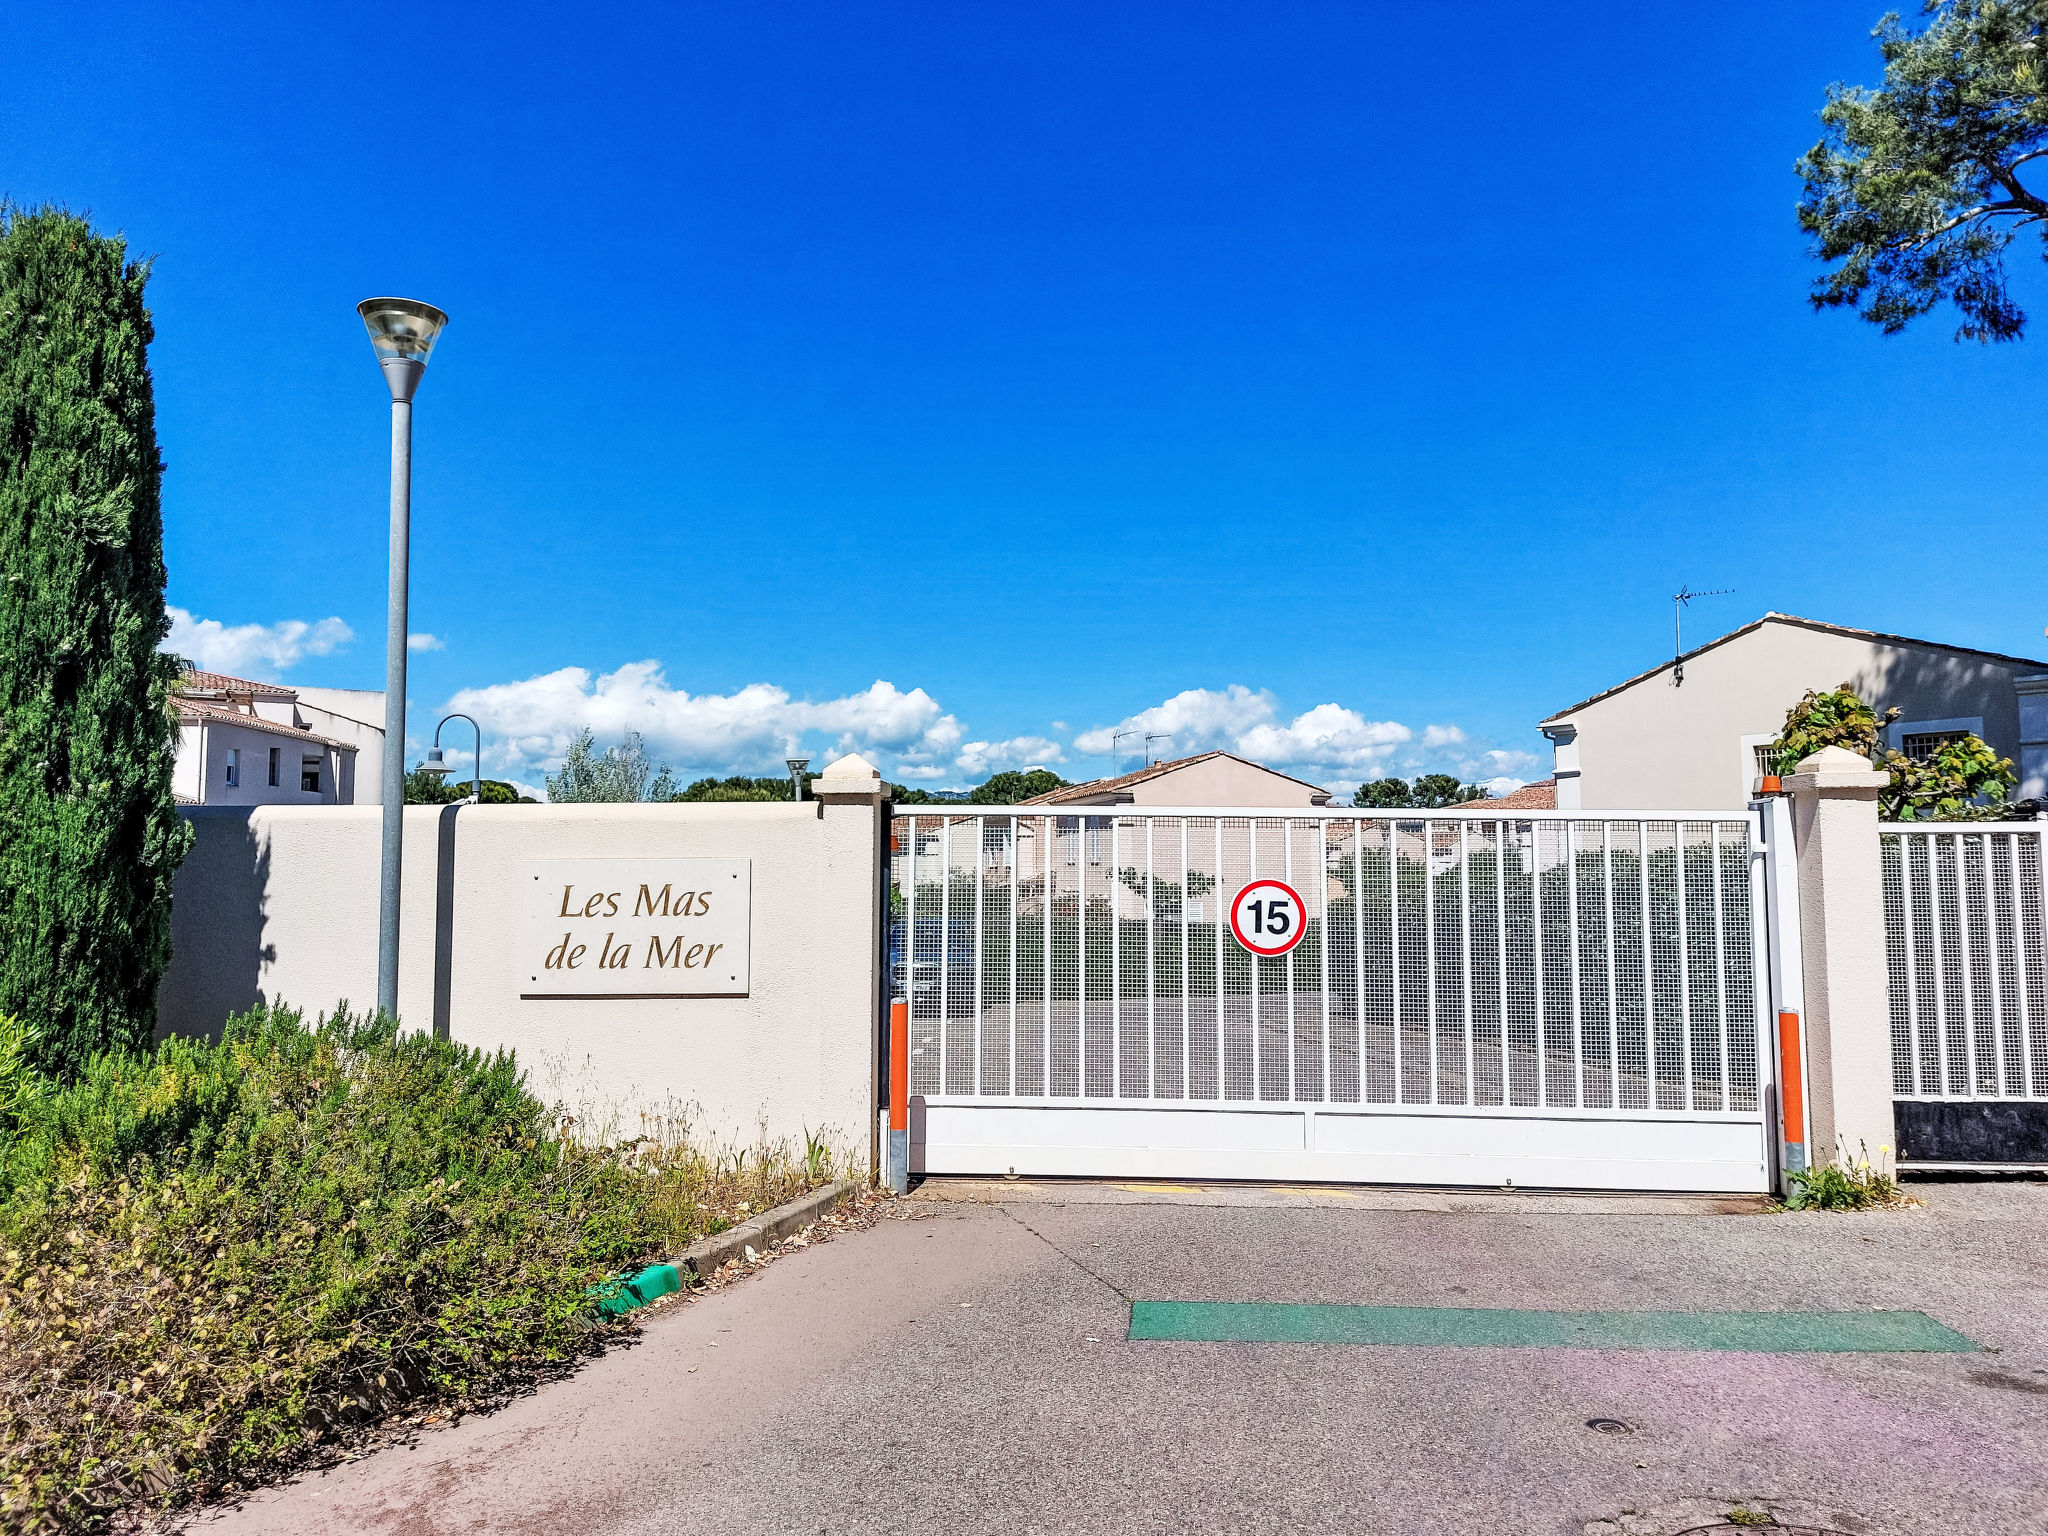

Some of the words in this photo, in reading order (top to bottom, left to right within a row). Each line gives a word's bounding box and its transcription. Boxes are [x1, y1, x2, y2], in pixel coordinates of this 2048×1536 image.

[557, 884, 622, 918] Les
[632, 883, 713, 917] Mas
[1247, 900, 1290, 935] 15
[544, 932, 587, 969] de
[598, 932, 632, 969] la
[643, 935, 724, 969] Mer
